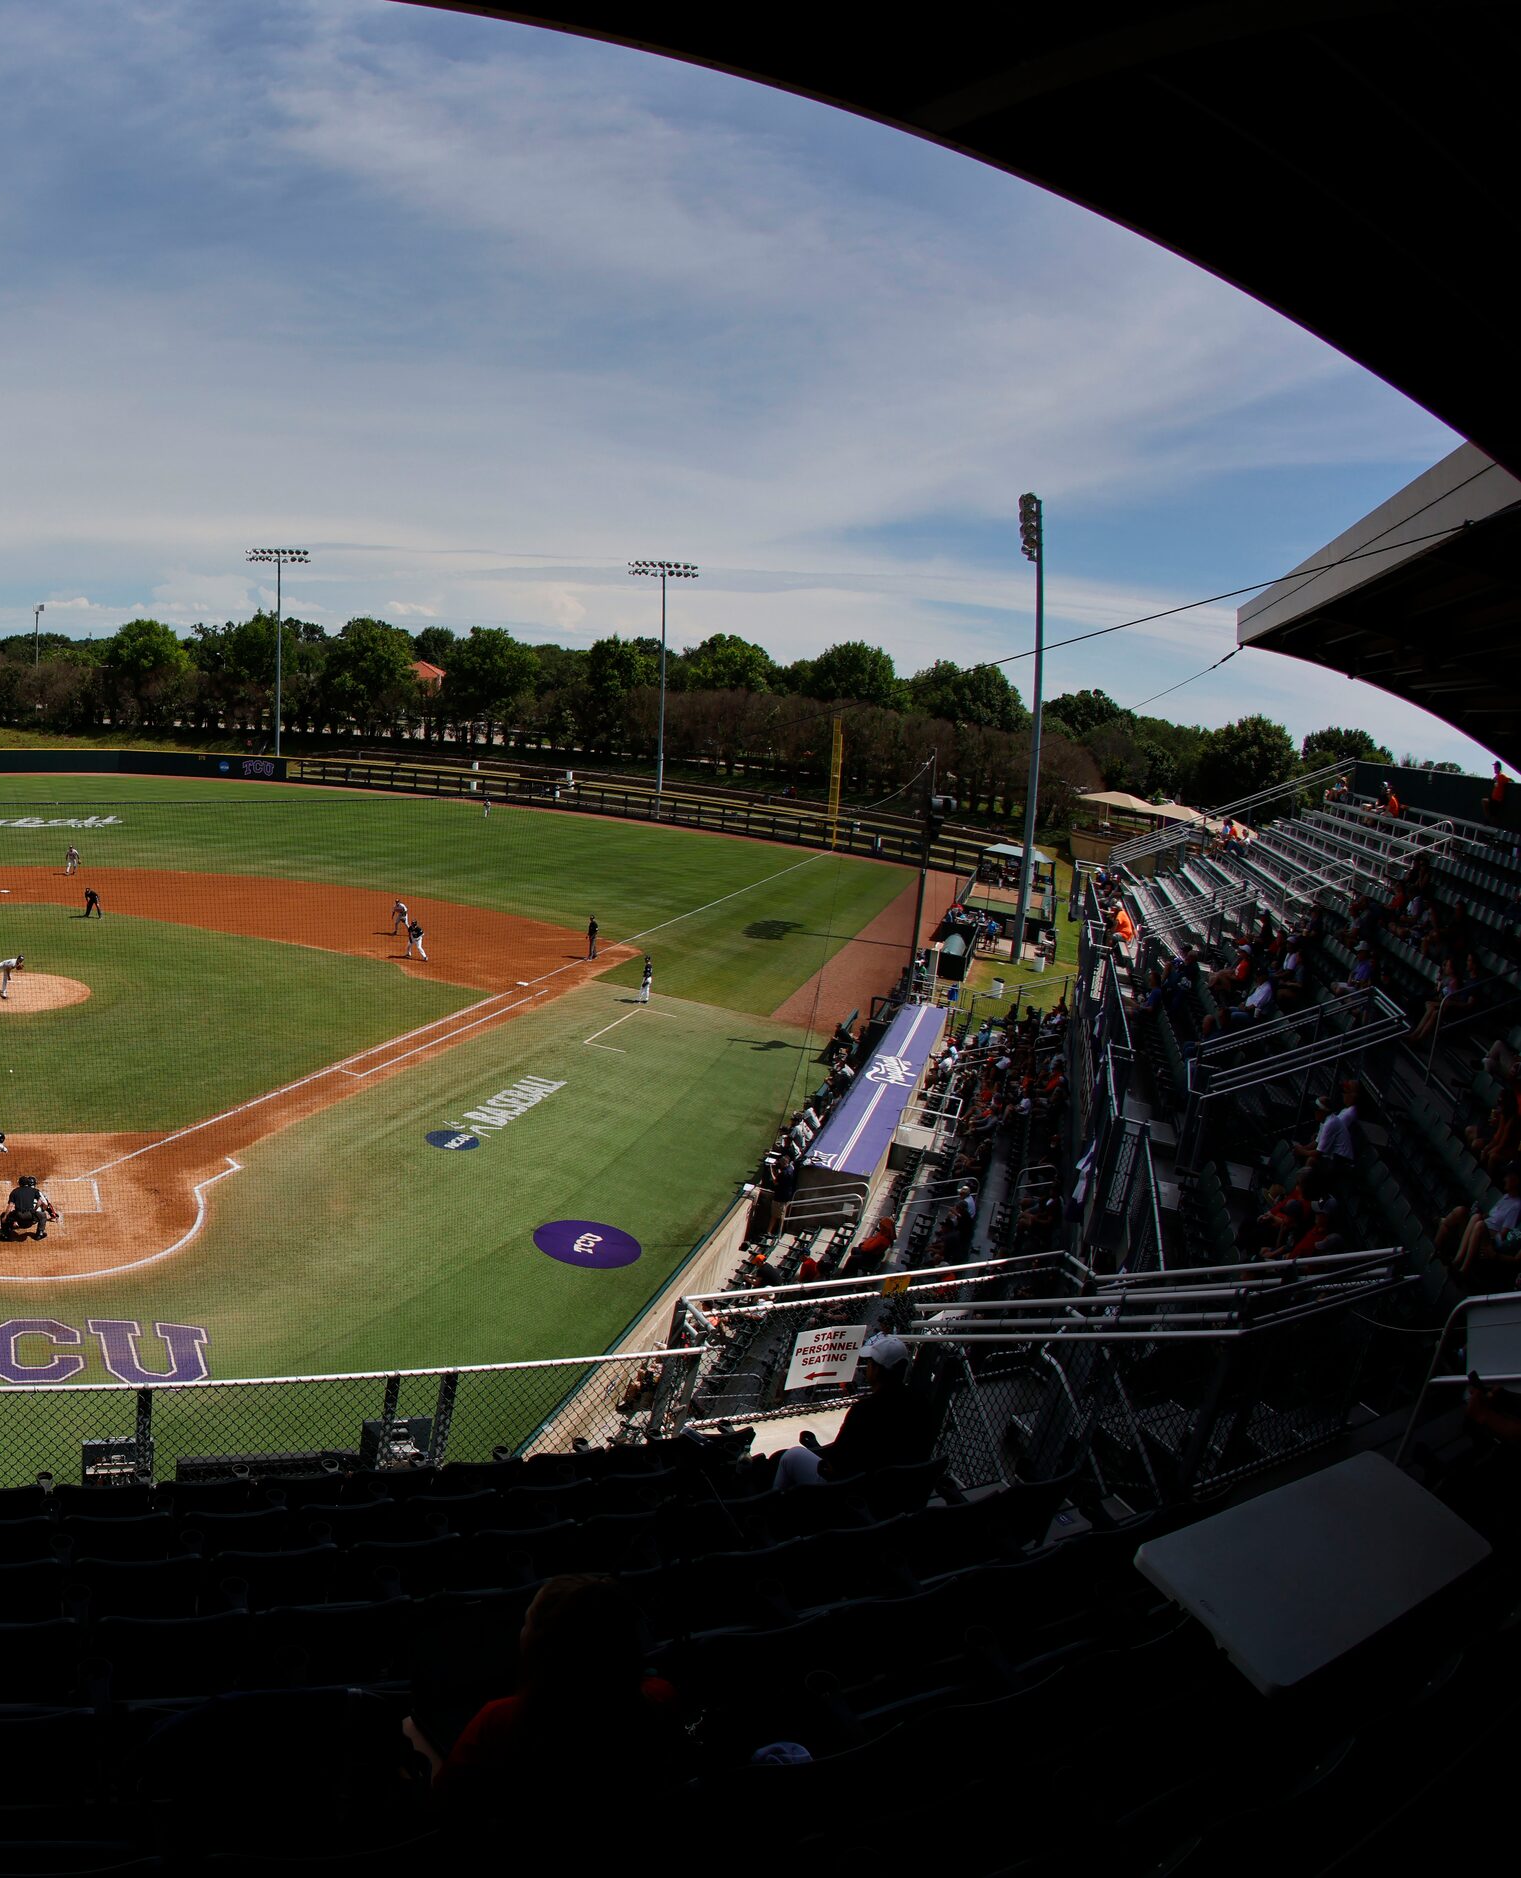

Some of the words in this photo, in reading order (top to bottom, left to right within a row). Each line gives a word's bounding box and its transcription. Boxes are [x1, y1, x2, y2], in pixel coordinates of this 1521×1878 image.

[242, 760, 275, 777] TCU
[444, 1133, 474, 1149] NCAA
[462, 1075, 568, 1127] BASEBALL
[573, 1232, 604, 1255] TCU
[813, 1331, 847, 1343] STAFF
[795, 1341, 859, 1357] PERSONNEL
[801, 1353, 848, 1366] SEATING
